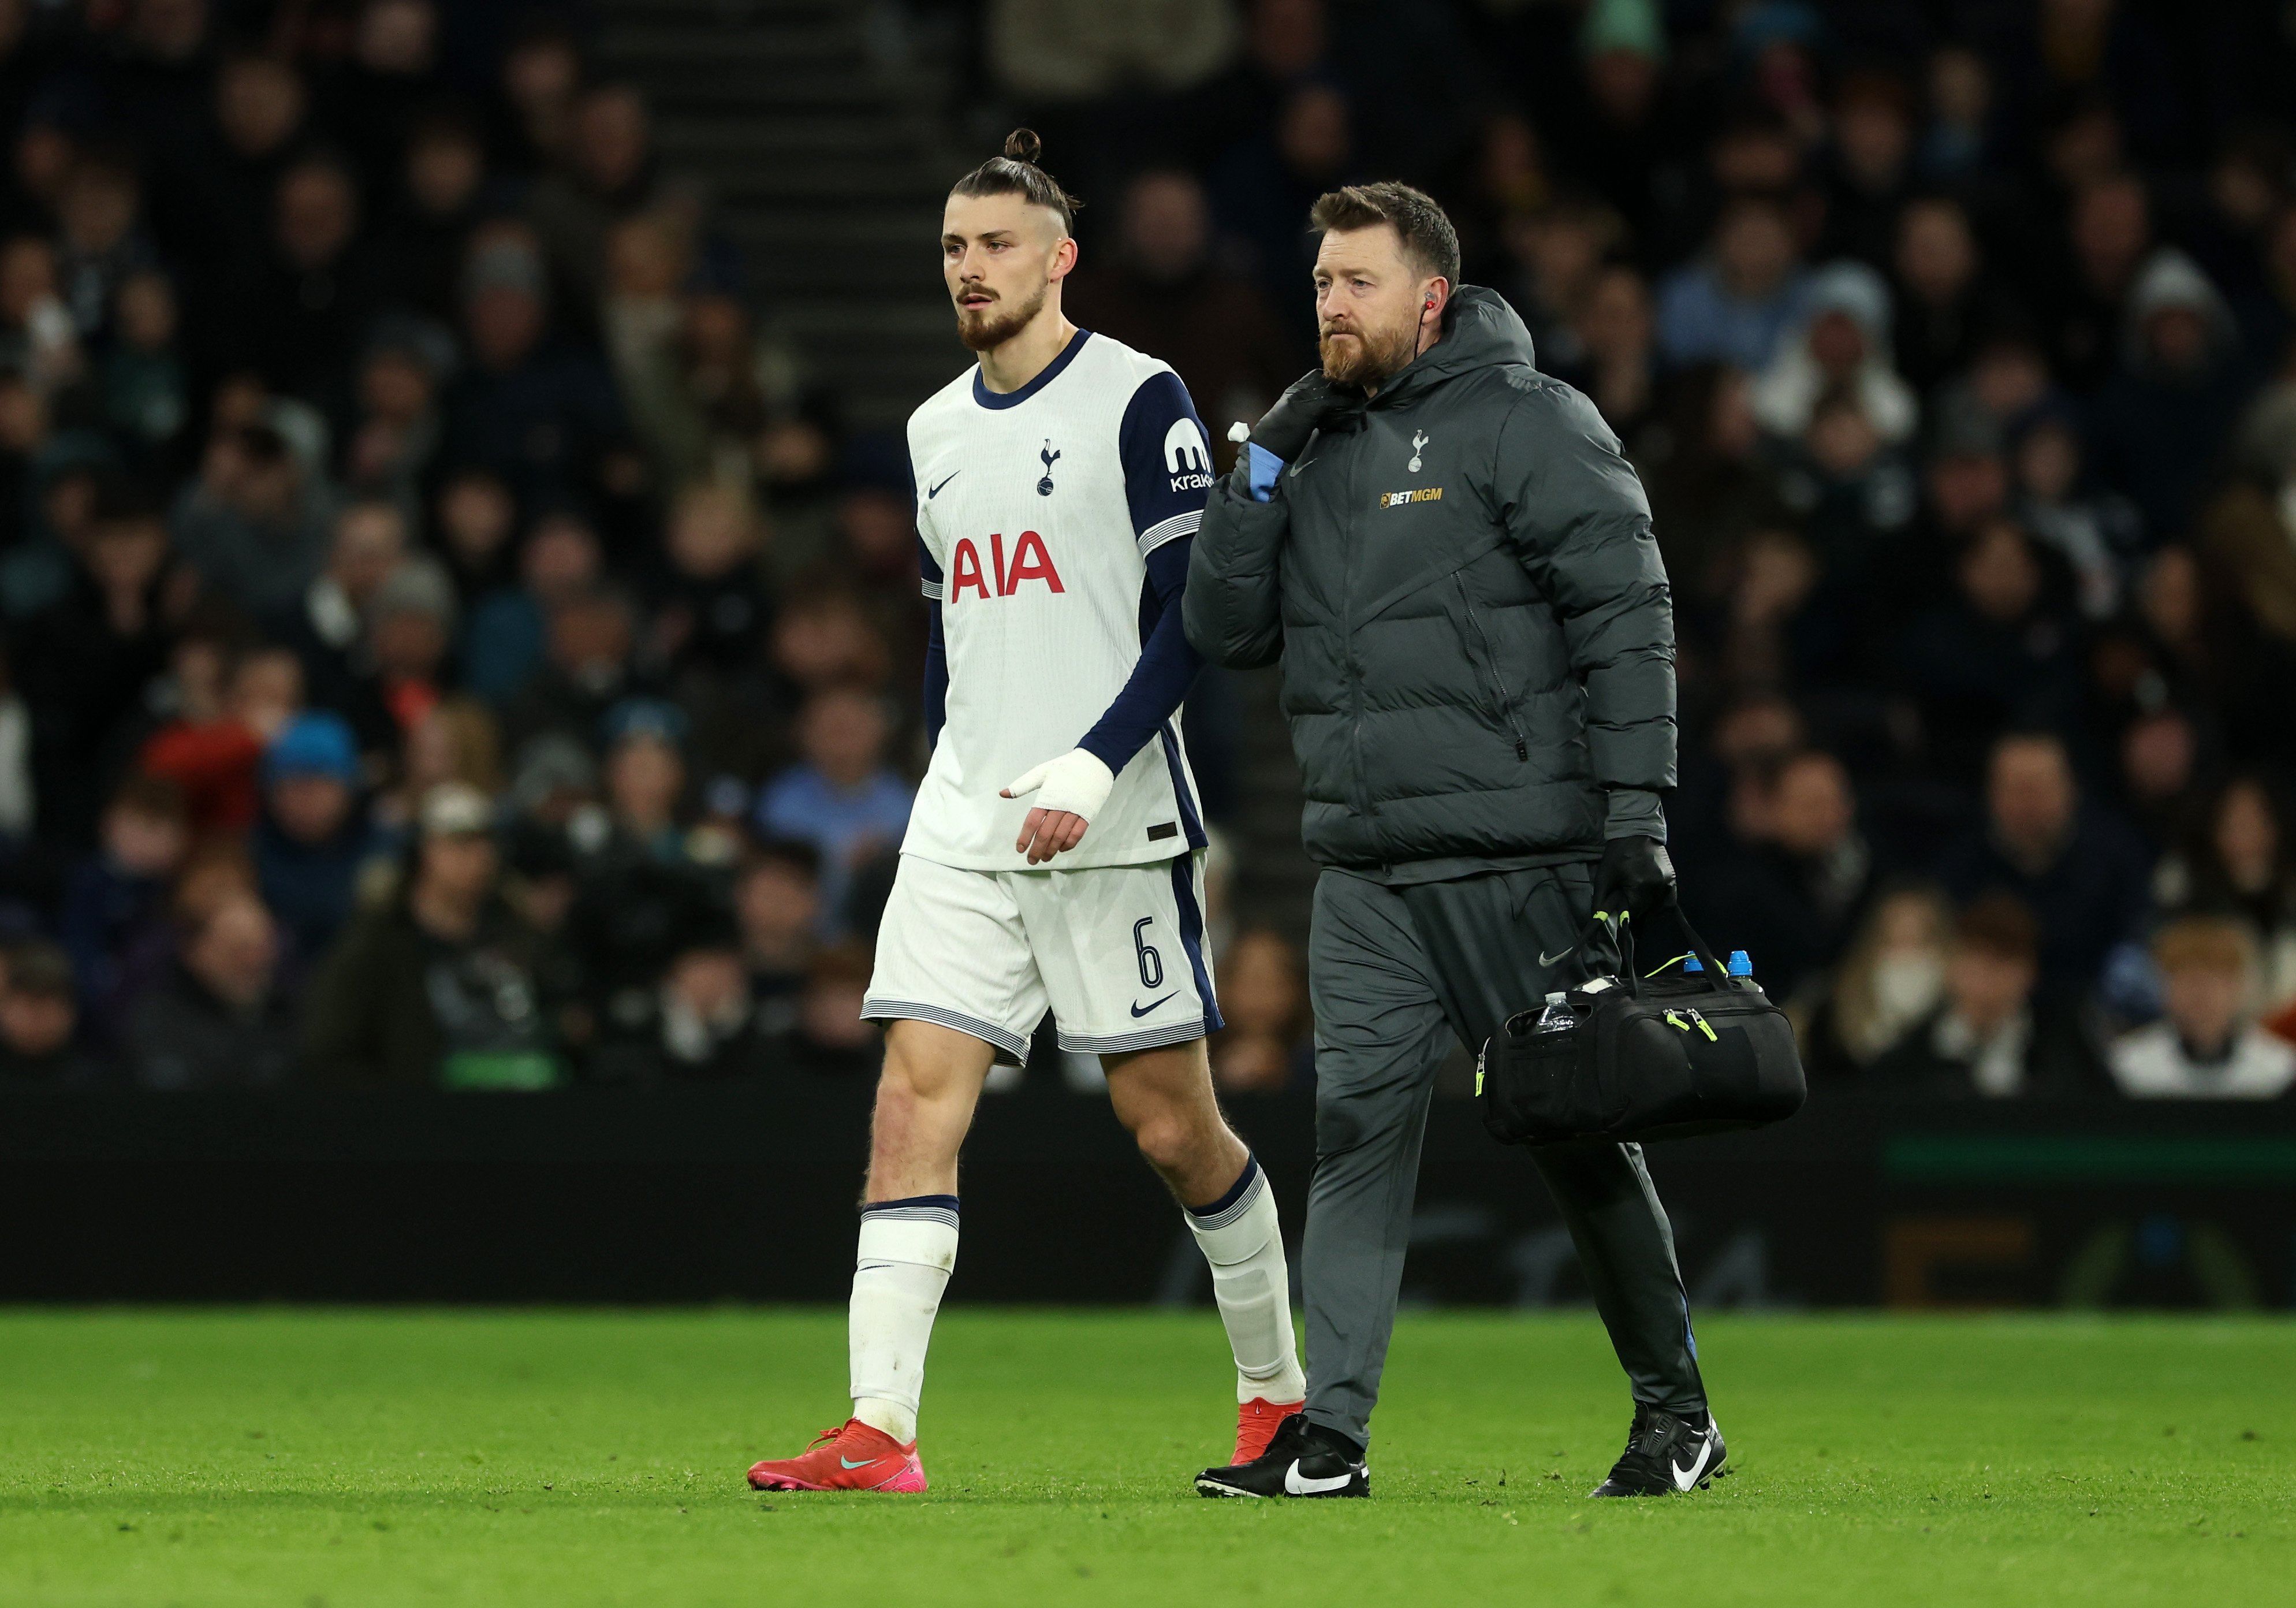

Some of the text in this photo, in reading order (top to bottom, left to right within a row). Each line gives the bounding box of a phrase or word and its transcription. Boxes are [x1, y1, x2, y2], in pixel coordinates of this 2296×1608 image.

[1171, 474, 1214, 492] krak
[1389, 488, 1444, 506] BETMGM
[952, 530, 1065, 604] AIA
[1133, 916, 1164, 989] 6
